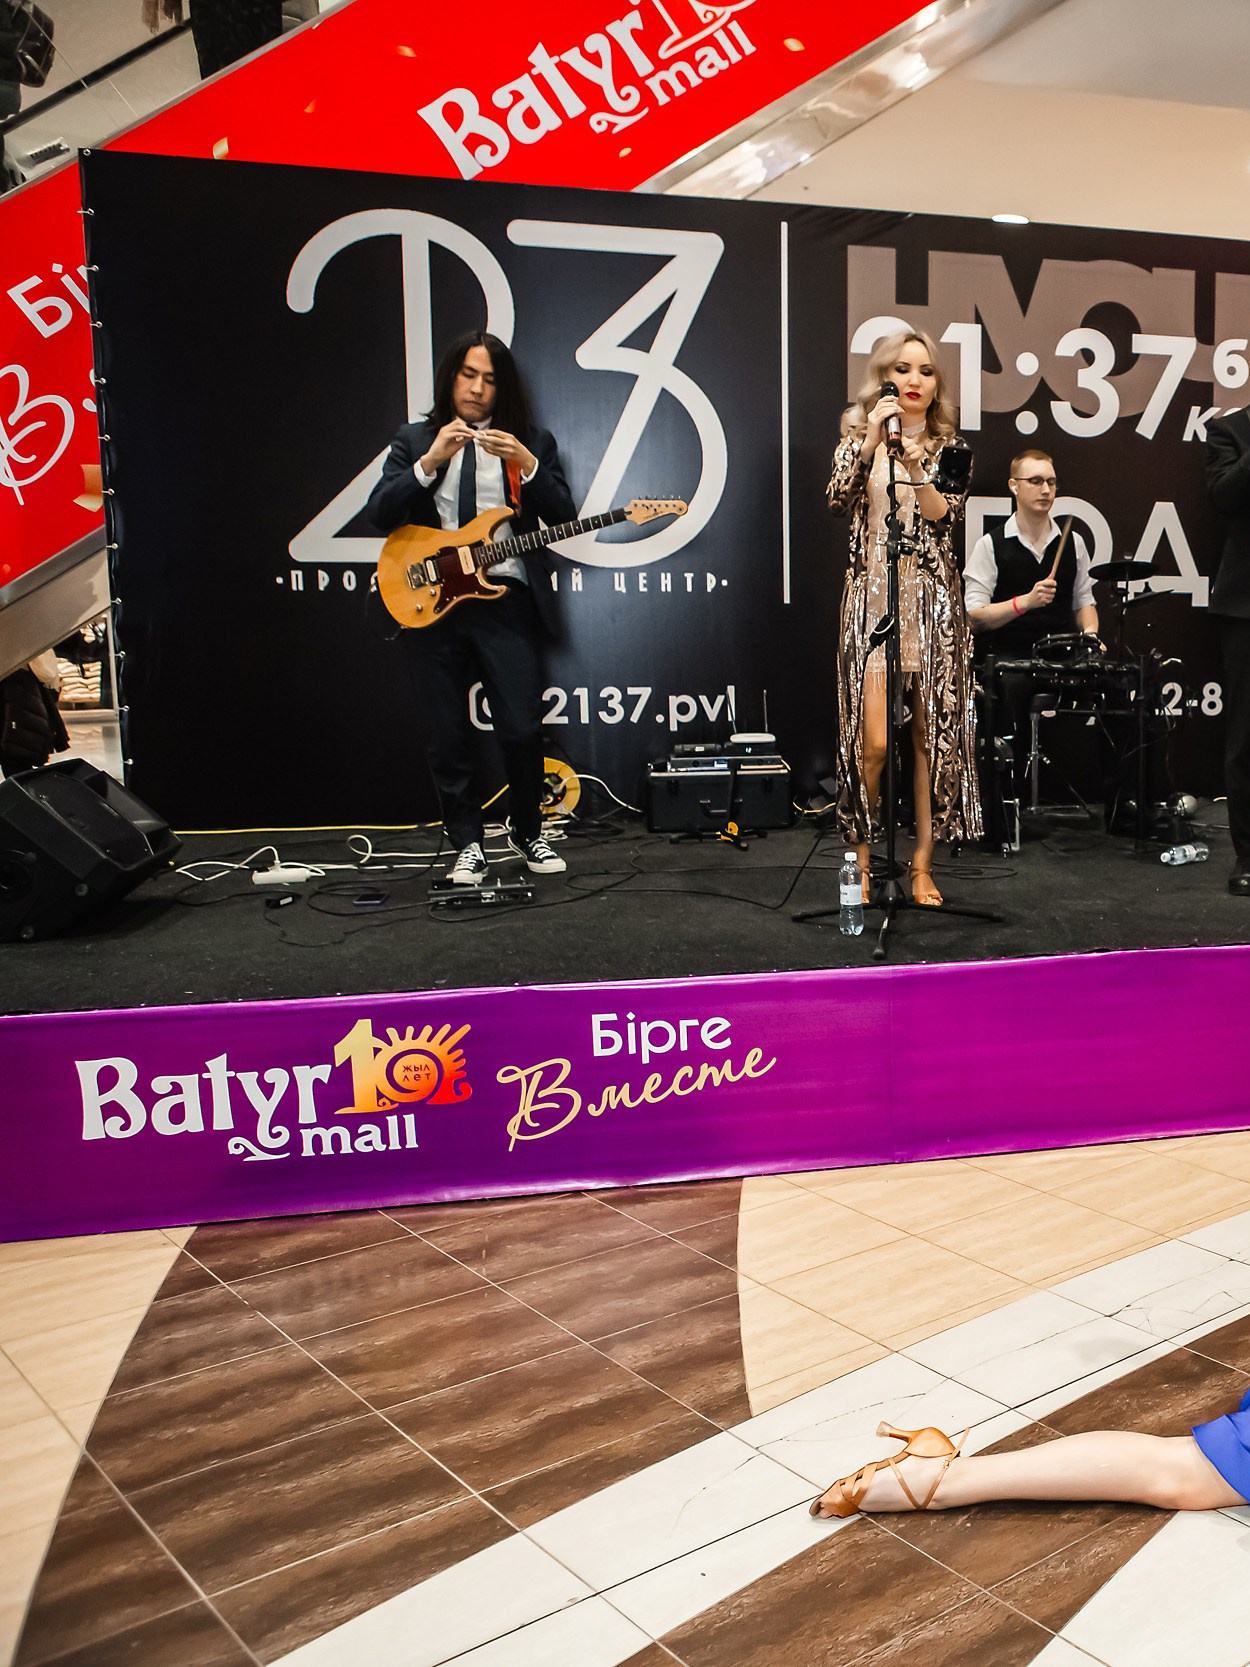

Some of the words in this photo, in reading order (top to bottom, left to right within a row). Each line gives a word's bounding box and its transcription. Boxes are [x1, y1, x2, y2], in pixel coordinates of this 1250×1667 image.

[417, 10, 655, 180] Batyr
[645, 19, 757, 106] mall
[591, 1012, 732, 1064] Бірге
[75, 1053, 331, 1161] Batyr
[300, 1113, 419, 1157] mall
[496, 1047, 777, 1152] Вместе
